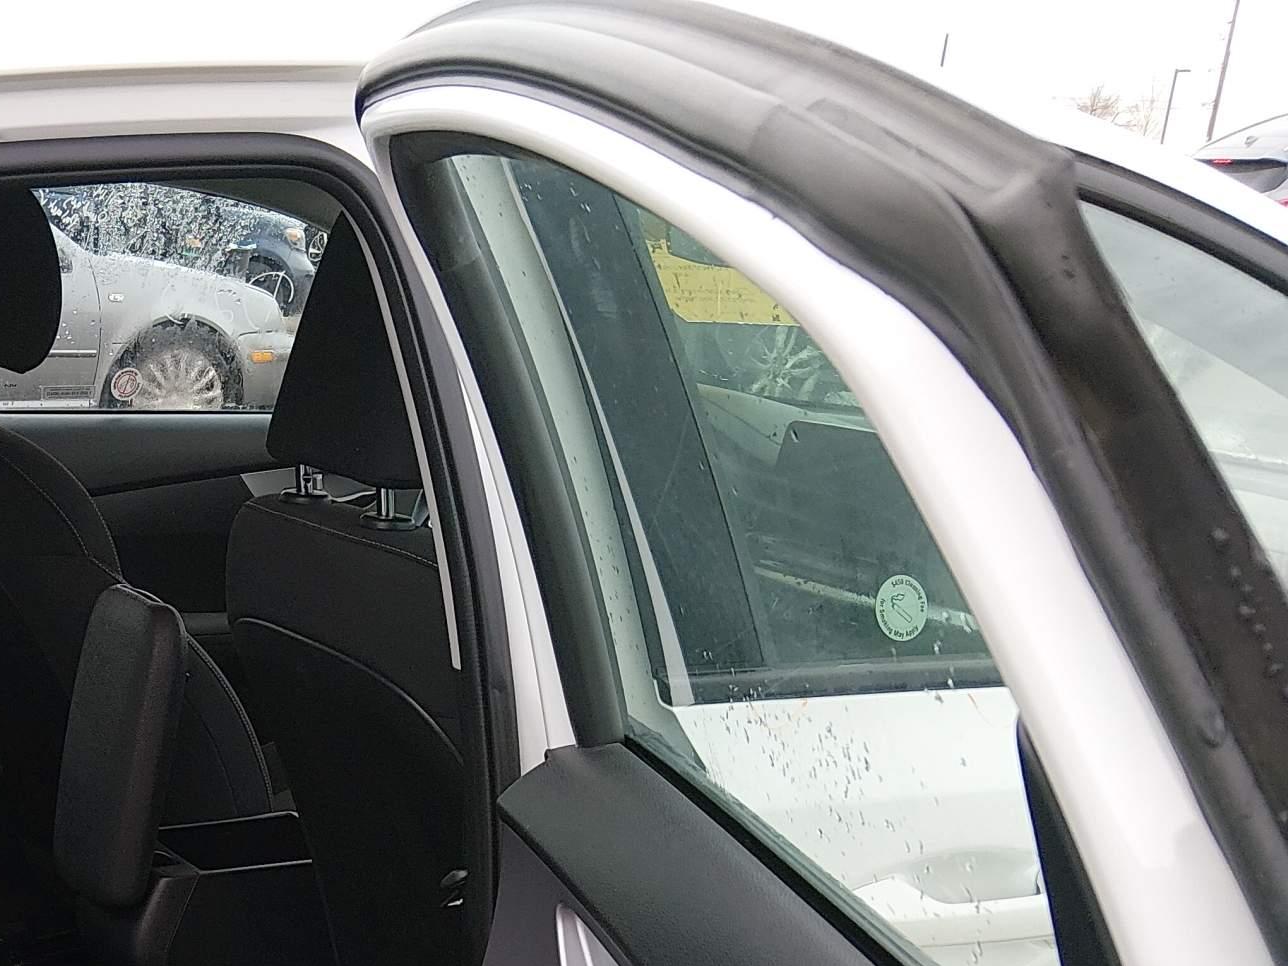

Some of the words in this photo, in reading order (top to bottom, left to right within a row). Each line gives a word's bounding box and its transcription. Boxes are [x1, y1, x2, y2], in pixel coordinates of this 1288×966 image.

[879, 607, 894, 635] Smoking
[893, 629, 905, 640] May
[905, 625, 919, 637] Apply
